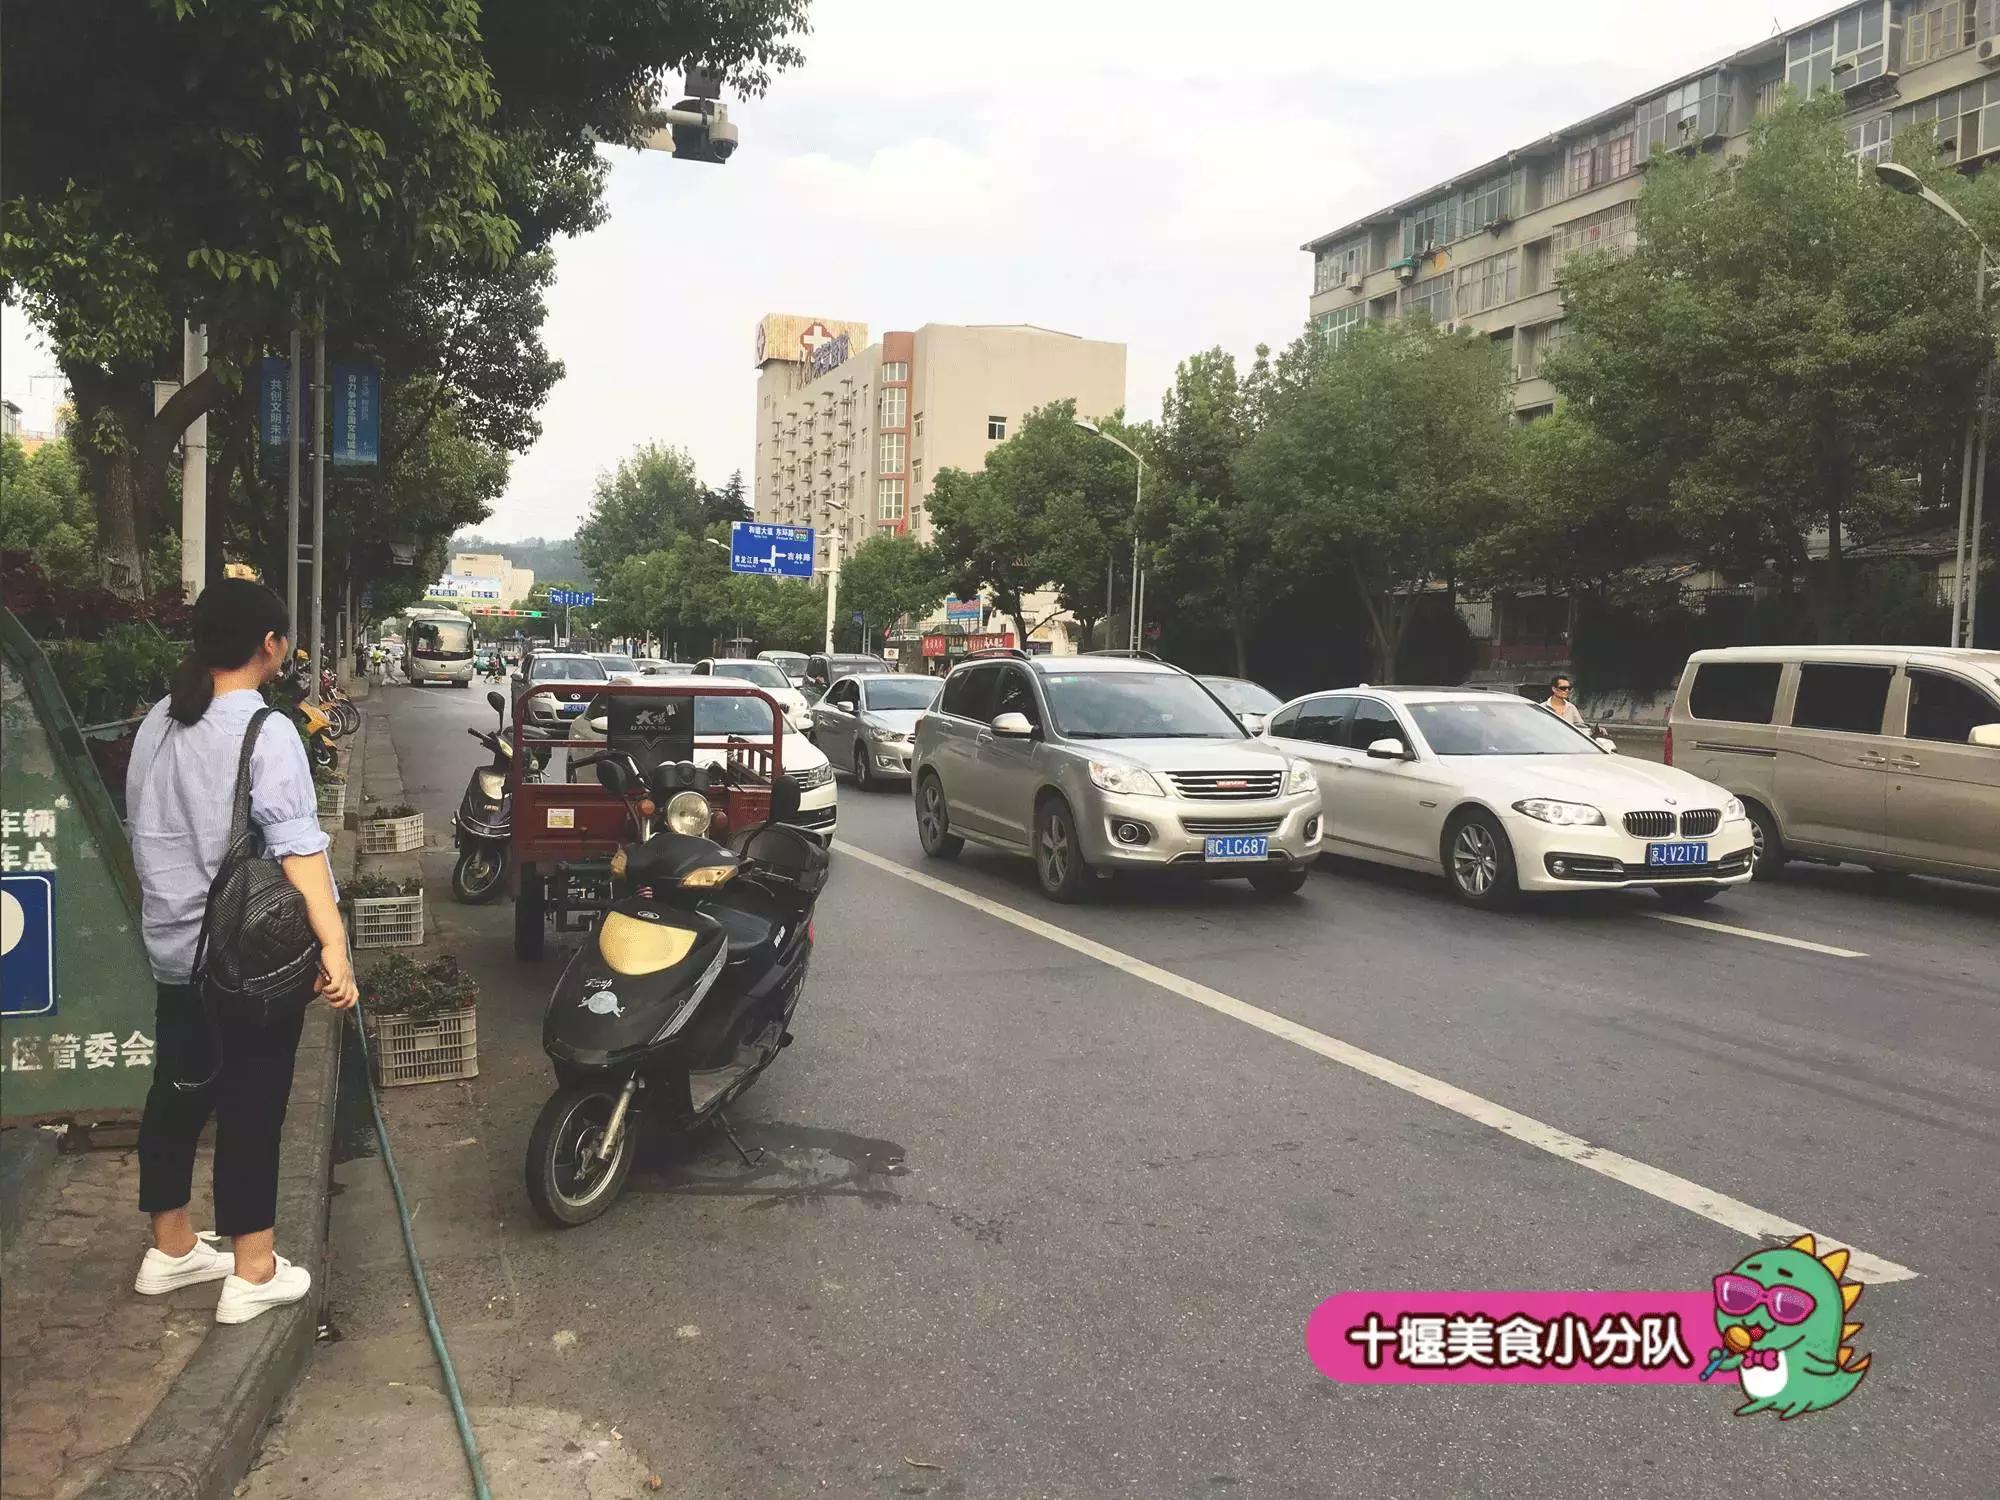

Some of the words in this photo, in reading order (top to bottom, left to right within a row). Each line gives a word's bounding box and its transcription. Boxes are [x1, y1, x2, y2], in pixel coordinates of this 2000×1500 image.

[270, 378, 282, 446] 共创文明未来
[734, 555, 759, 565] 黑龙江路
[787, 552, 811, 562] 吉林路
[1, 1030, 155, 1073] 区管委会
